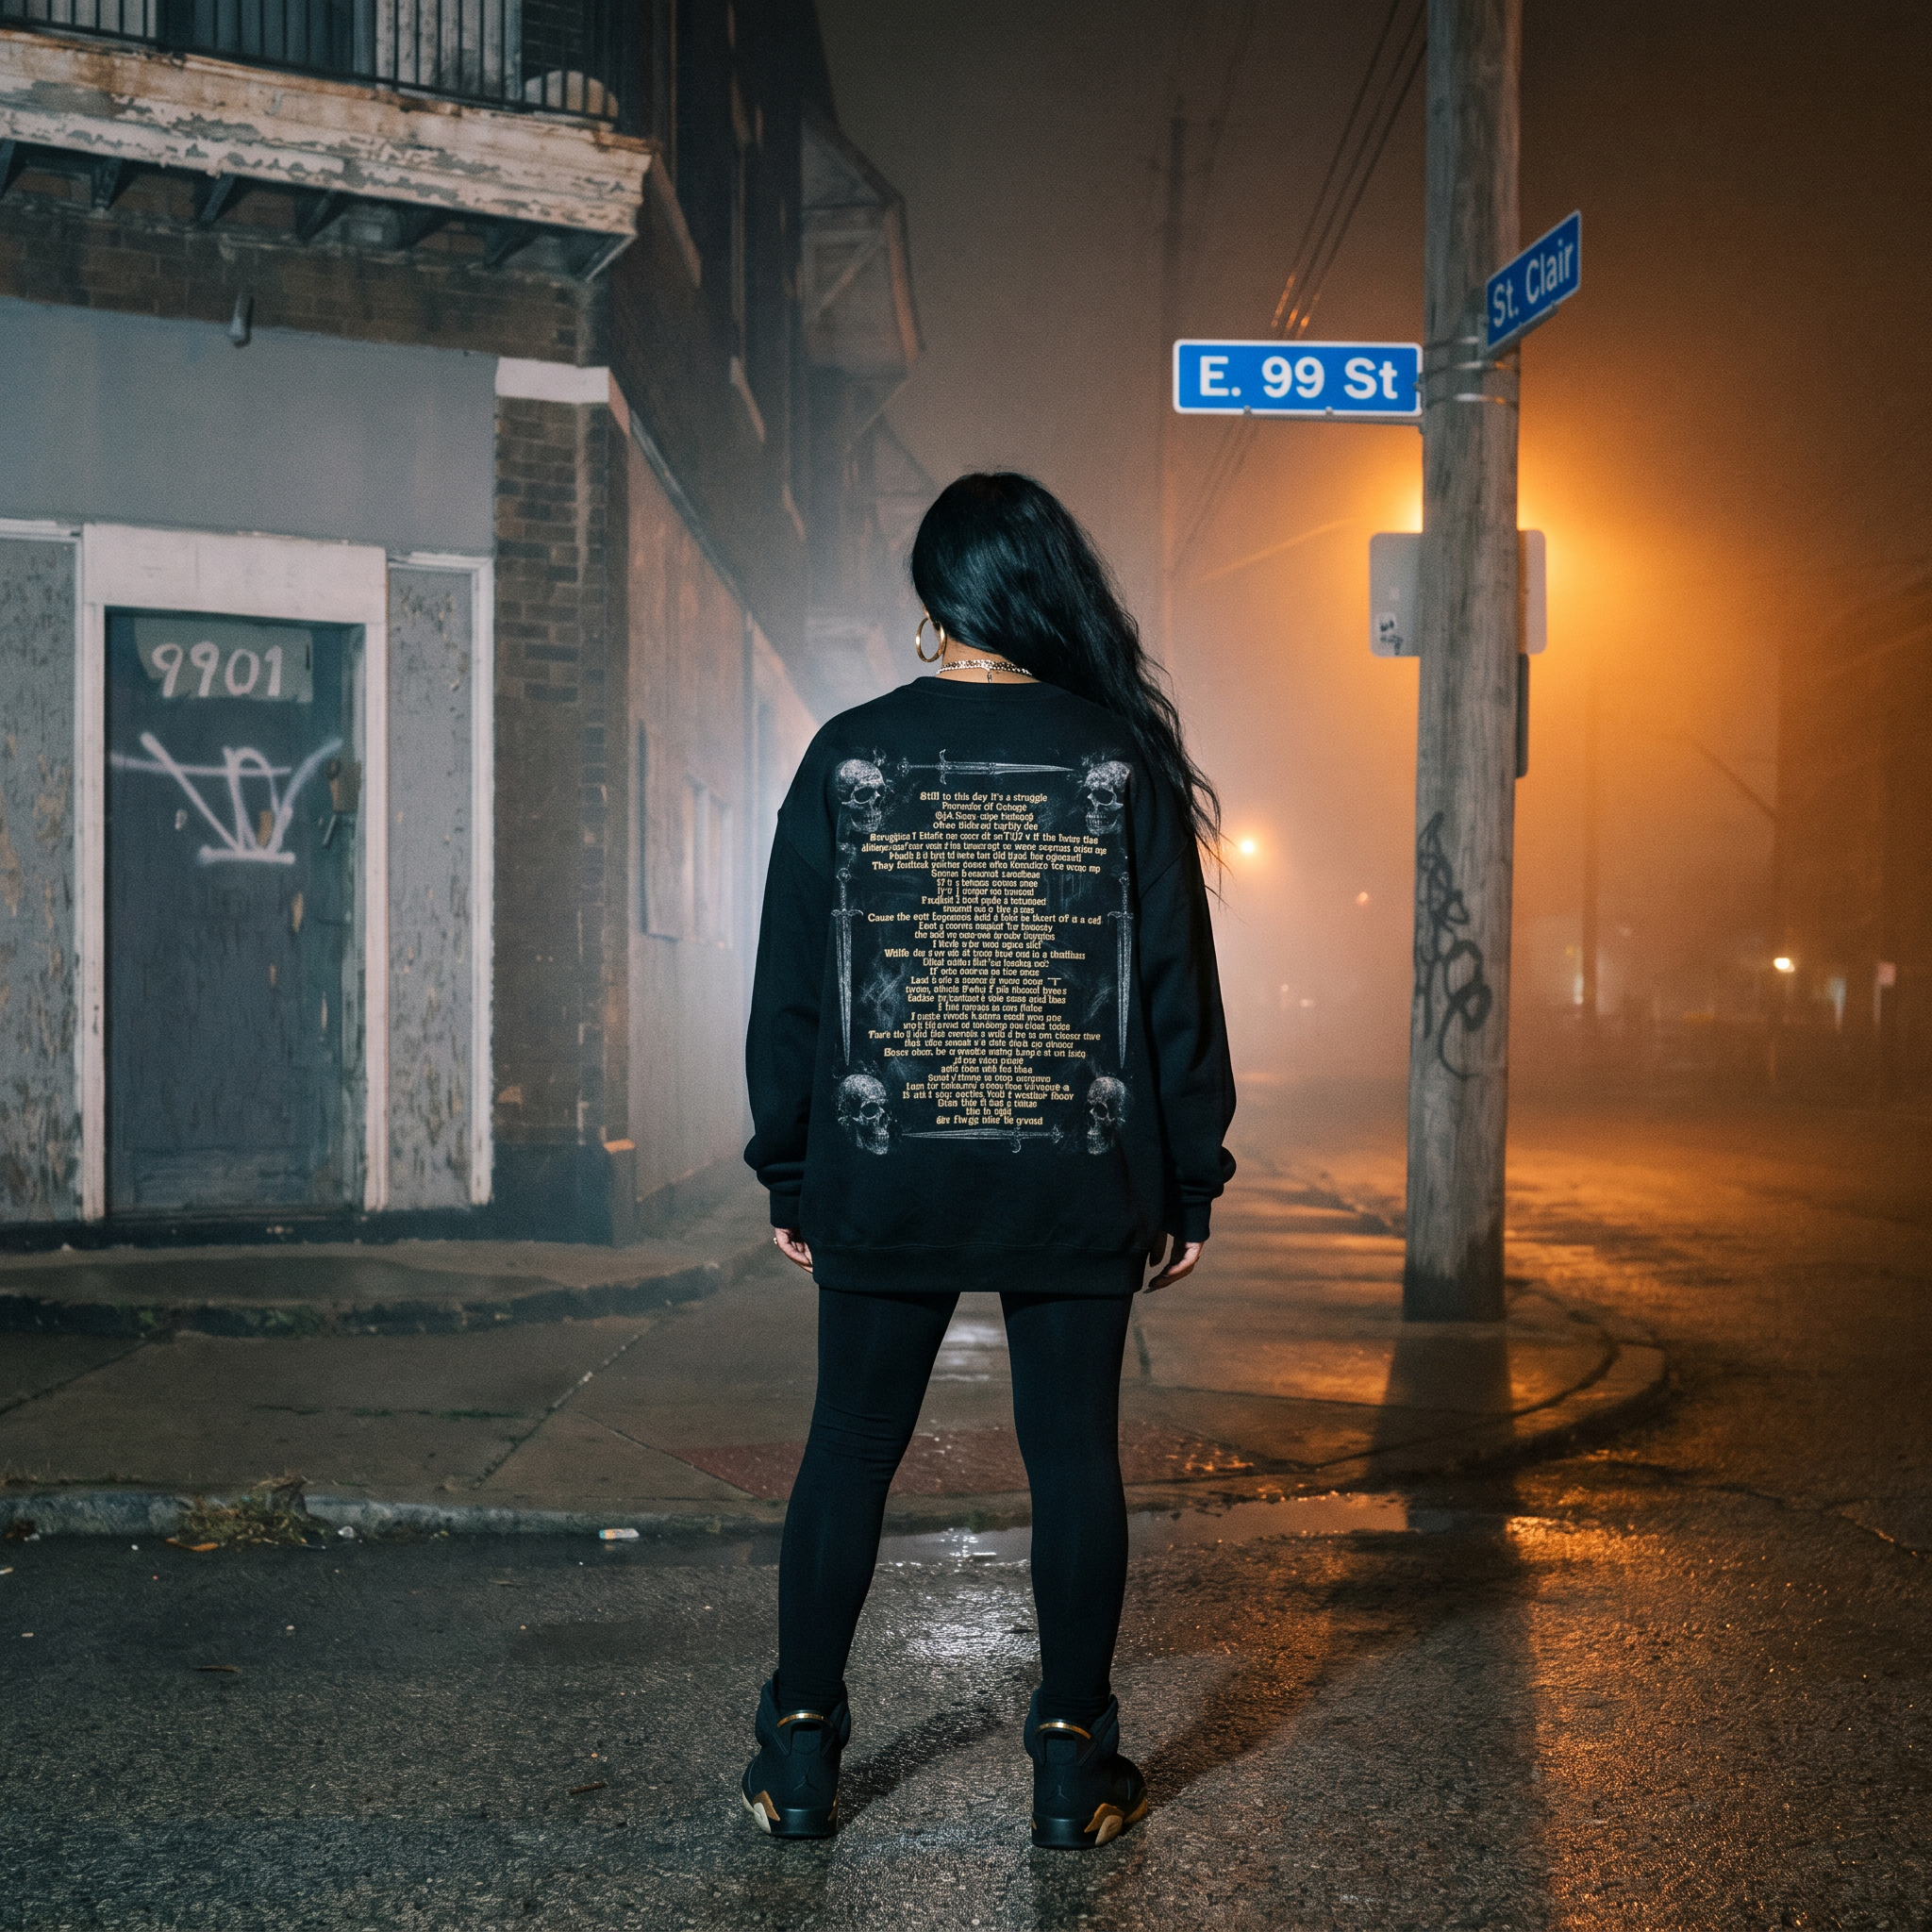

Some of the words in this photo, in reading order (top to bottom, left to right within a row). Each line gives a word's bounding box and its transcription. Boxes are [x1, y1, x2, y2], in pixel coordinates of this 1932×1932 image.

[1492, 278, 1520, 328] St.
[1525, 238, 1574, 305] Clair
[1200, 356, 1241, 397] E.
[1261, 356, 1325, 398] 99
[1343, 357, 1398, 400] St
[151, 641, 283, 697] 9901
[1013, 793, 1047, 804] struggle
